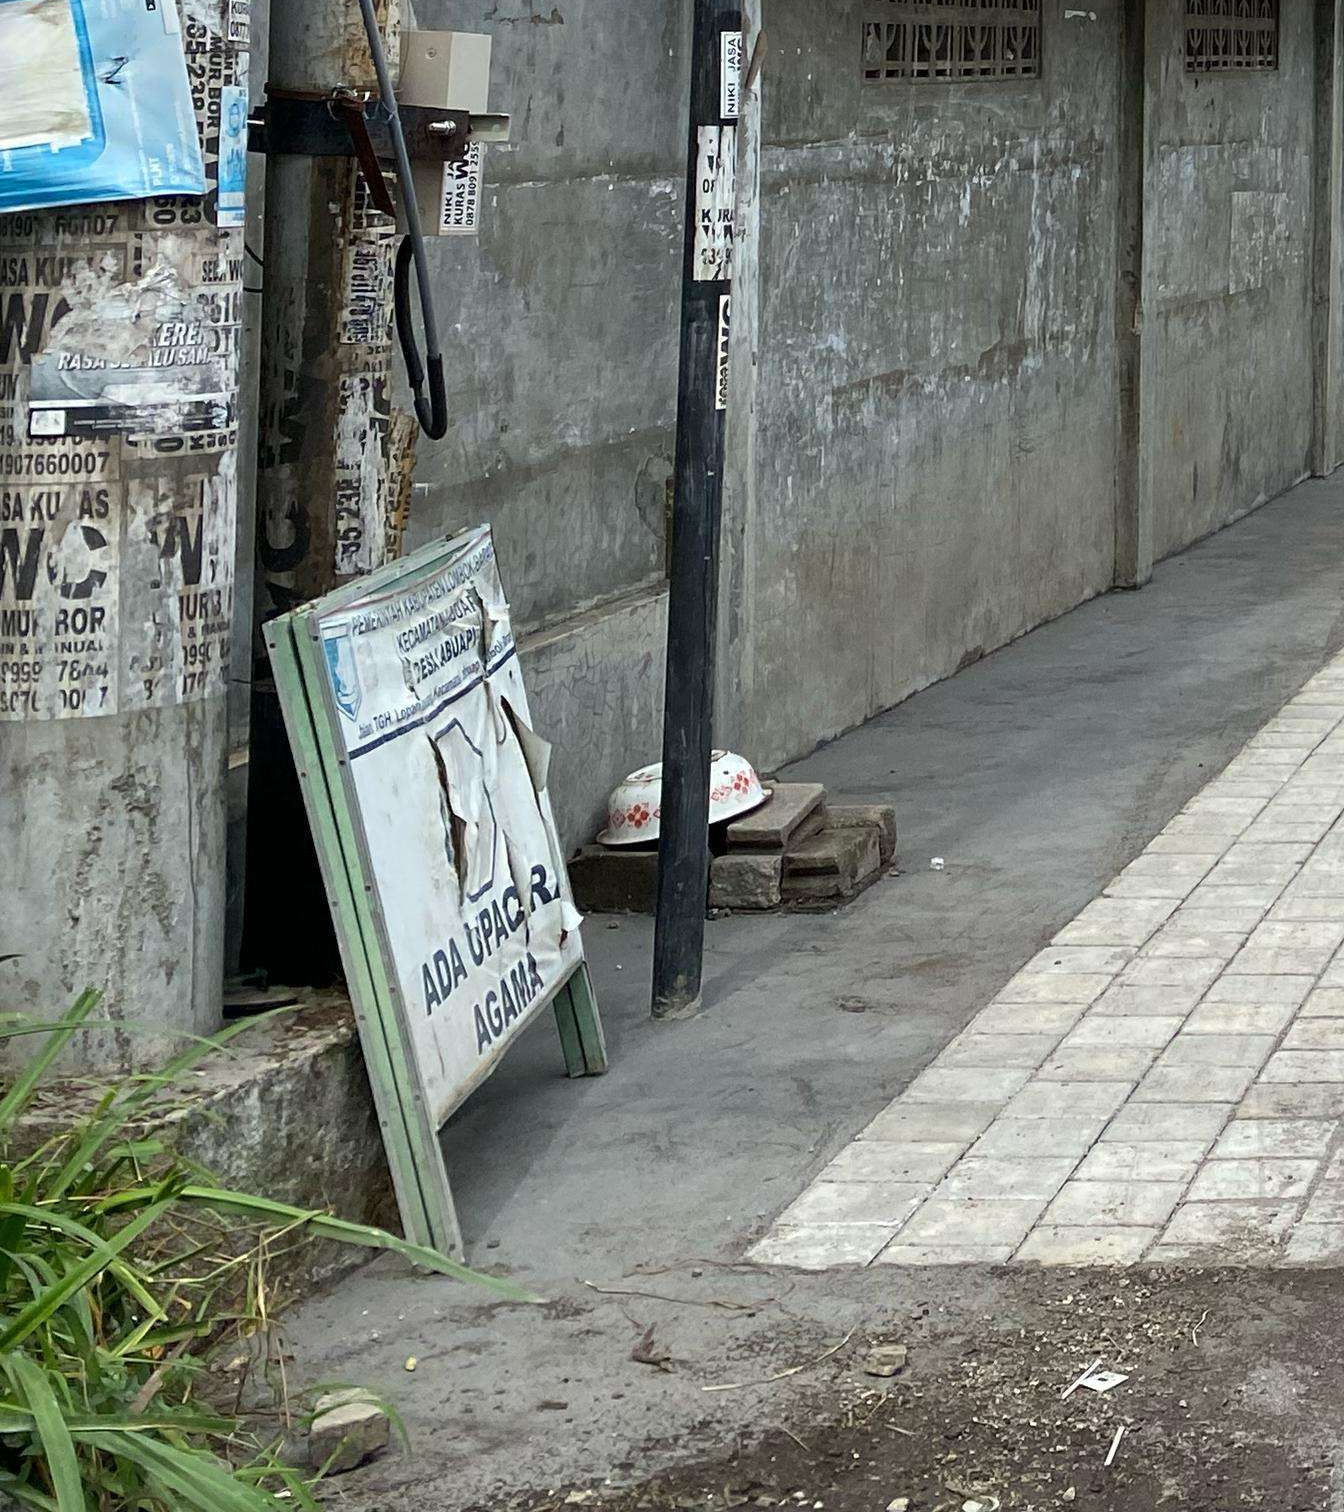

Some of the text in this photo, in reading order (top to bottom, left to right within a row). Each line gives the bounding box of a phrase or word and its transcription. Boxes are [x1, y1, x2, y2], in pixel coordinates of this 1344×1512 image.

[726, 37, 737, 114] NIKI JASA
[444, 191, 454, 225] NIKI
[453, 183, 466, 225] KURAS
[465, 198, 474, 226] 0878
[30, 489, 109, 521] KUAS
[352, 601, 402, 636] PEMERINTAH
[421, 937, 468, 1016] ADA
[473, 951, 544, 1056] AGAMA
